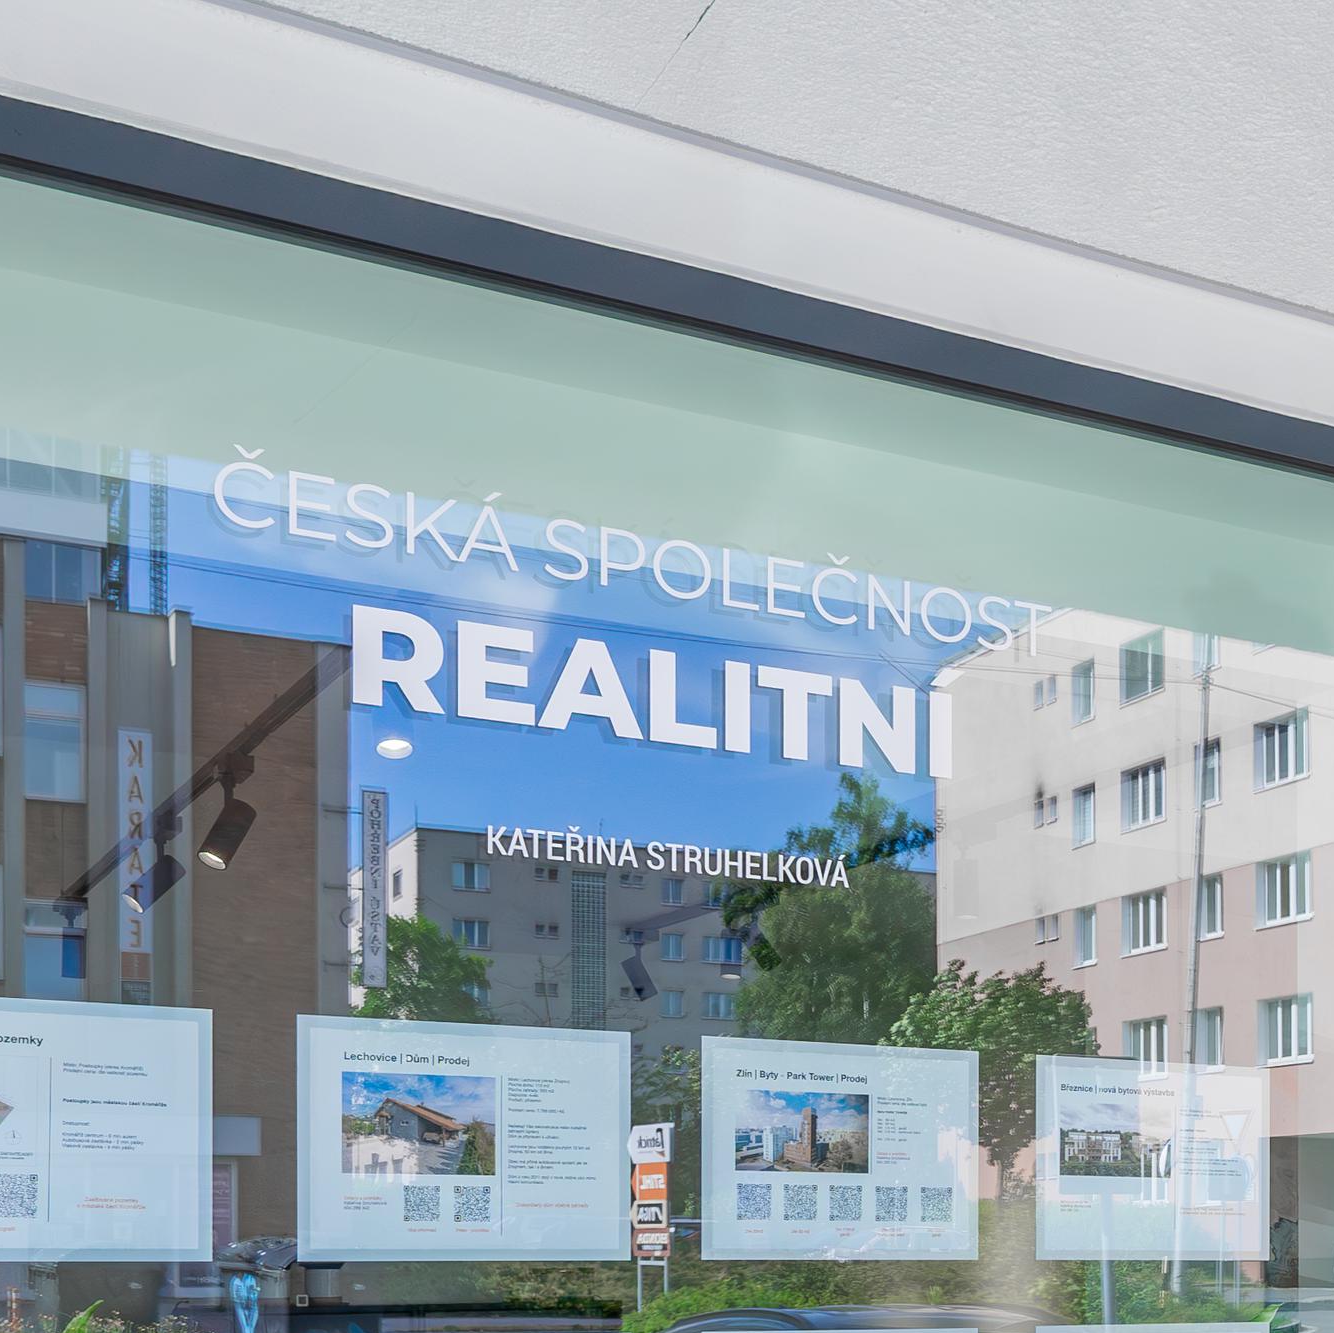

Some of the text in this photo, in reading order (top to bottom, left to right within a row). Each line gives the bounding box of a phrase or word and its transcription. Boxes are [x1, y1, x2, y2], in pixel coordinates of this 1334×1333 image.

[213, 444, 1052, 656] ČESKÁ SPOLEČNOST
[351, 604, 955, 778] REALITNÍ
[486, 825, 851, 891] KATEŘINA STRUHELKOVÁ
[344, 1052, 397, 1063] Lechovice
[406, 1053, 429, 1064] Dům
[438, 1056, 470, 1067] Prodej
[759, 1070, 779, 1080] Byty
[787, 1072, 806, 1081] Park
[809, 1073, 834, 1082] Tower
[841, 1074, 868, 1084] Prodej
[1061, 1084, 1093, 1093] Březnice
[1099, 1086, 1116, 1094] nová
[1118, 1087, 1141, 1096] bytová
